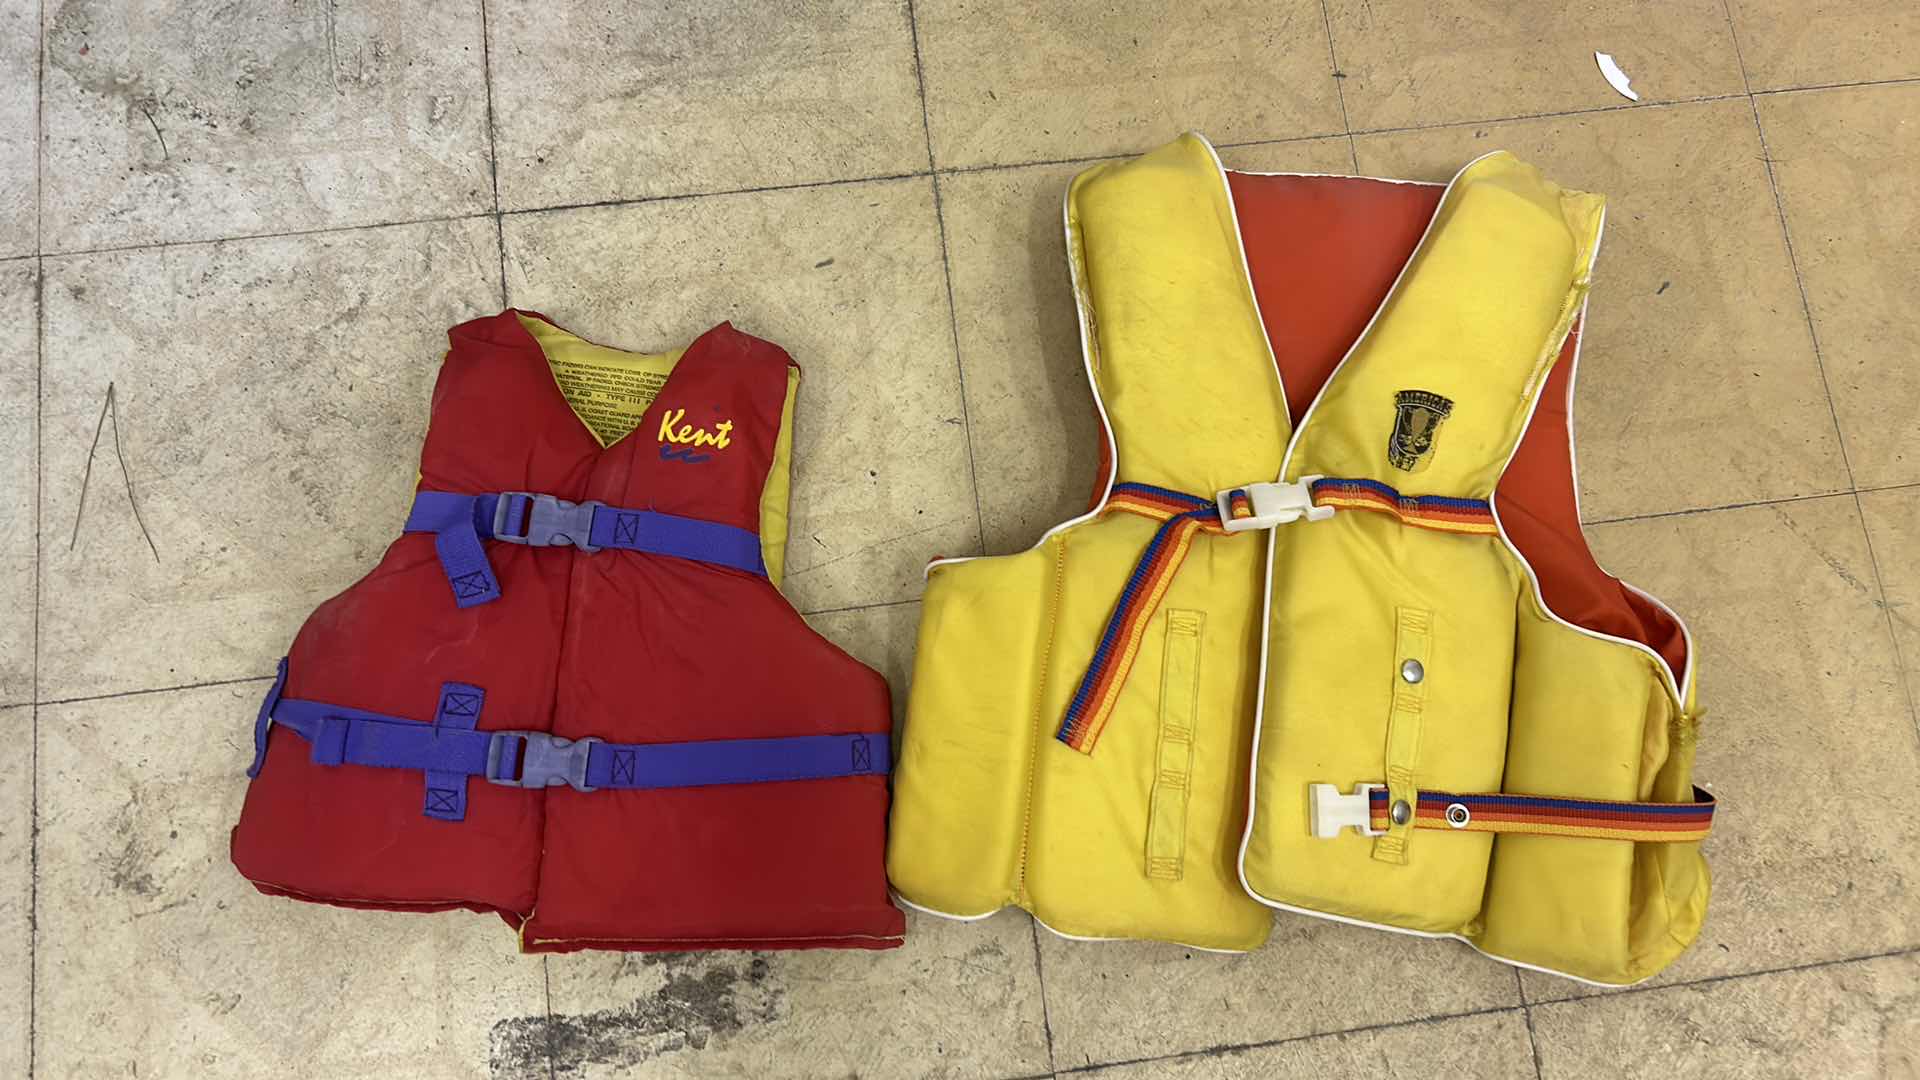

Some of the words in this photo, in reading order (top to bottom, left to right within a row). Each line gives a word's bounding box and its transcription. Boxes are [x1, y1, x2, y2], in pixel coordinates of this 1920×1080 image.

[577, 390, 591, 398] AID
[606, 393, 625, 402] TYPE
[628, 396, 640, 404] III
[657, 408, 733, 449] Kent
